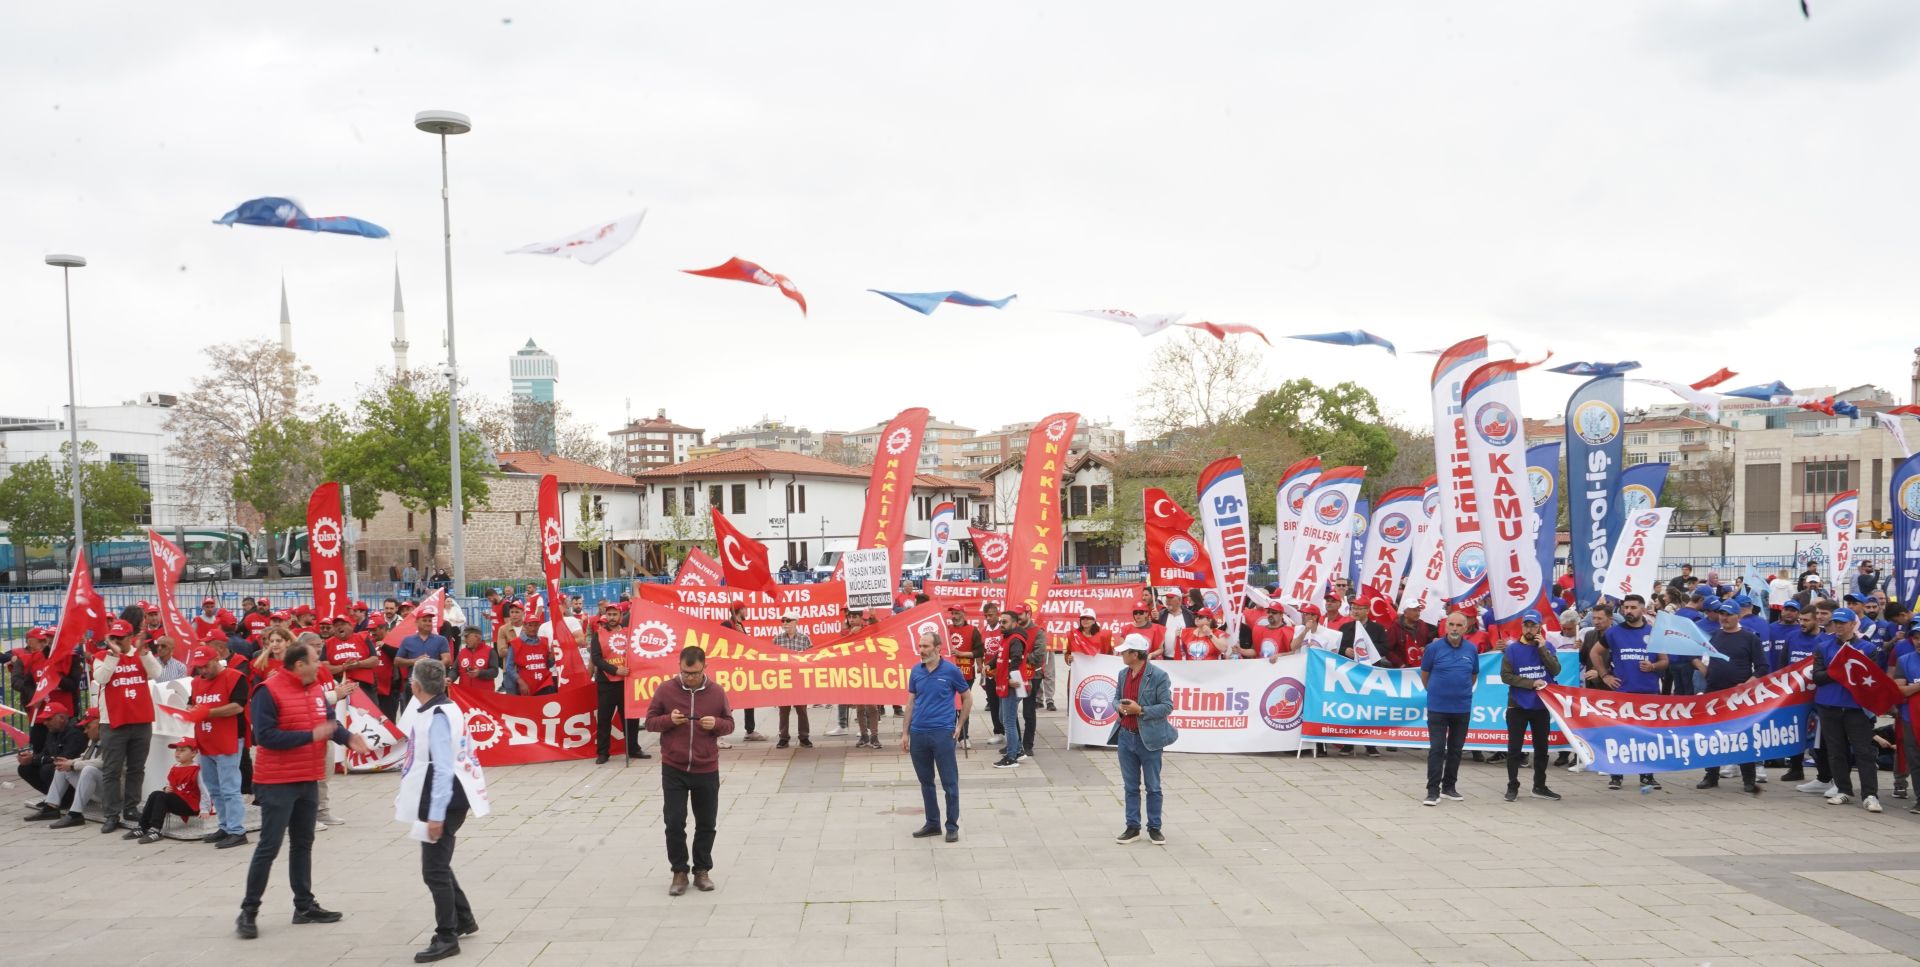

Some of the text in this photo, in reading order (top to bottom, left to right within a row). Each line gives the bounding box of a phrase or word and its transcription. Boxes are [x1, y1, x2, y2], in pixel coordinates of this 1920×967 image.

[1029, 442, 1059, 572] NAKLİYAT
[1488, 453, 1523, 542] KAMU
[1506, 549, 1530, 601] İŞ
[1585, 449, 1612, 592] petrol-iş
[317, 530, 337, 542] DİSK
[1303, 526, 1342, 545] BİRLEŞİK
[151, 539, 180, 572] DİSK
[1853, 546, 1890, 555] vrupa
[1425, 539, 1445, 581] KAMU
[1618, 529, 1649, 593] KAMU İŞ
[1291, 543, 1327, 606] KAM
[1370, 546, 1399, 594] KAM
[322, 569, 338, 619] Dİ
[677, 590, 743, 607] YAŞASIN
[749, 590, 757, 603] 1
[934, 585, 979, 597] SEFALET
[1047, 587, 1134, 600] OKSULLAŞMAYA
[1040, 599, 1084, 614] HAYIR
[812, 620, 842, 634] GÜNÜ
[336, 642, 356, 650] DİSK
[639, 633, 668, 647] DİSK
[334, 650, 363, 661] GENEL
[115, 664, 139, 674] DİSK
[534, 672, 543, 681] İŞ
[112, 676, 146, 687] GENEL
[715, 666, 793, 693] BÖLGE
[124, 688, 137, 700] İŞ
[195, 693, 221, 704] DİSK
[1553, 691, 1697, 721] YAŞASIN
[1725, 663, 1817, 712] MAYIS
[202, 721, 212, 733] İŞ
[469, 720, 494, 733] DİSK
[1184, 716, 1246, 729] TEMSİLCİLİĞİ
[1321, 726, 1357, 736] BİRLEŞİK
[1358, 728, 1382, 737] KAMU
[1388, 728, 1397, 738] İŞ
[1398, 730, 1420, 738] KOLU
[1604, 715, 1800, 766] Petrol-İş Gebze Şubesi
